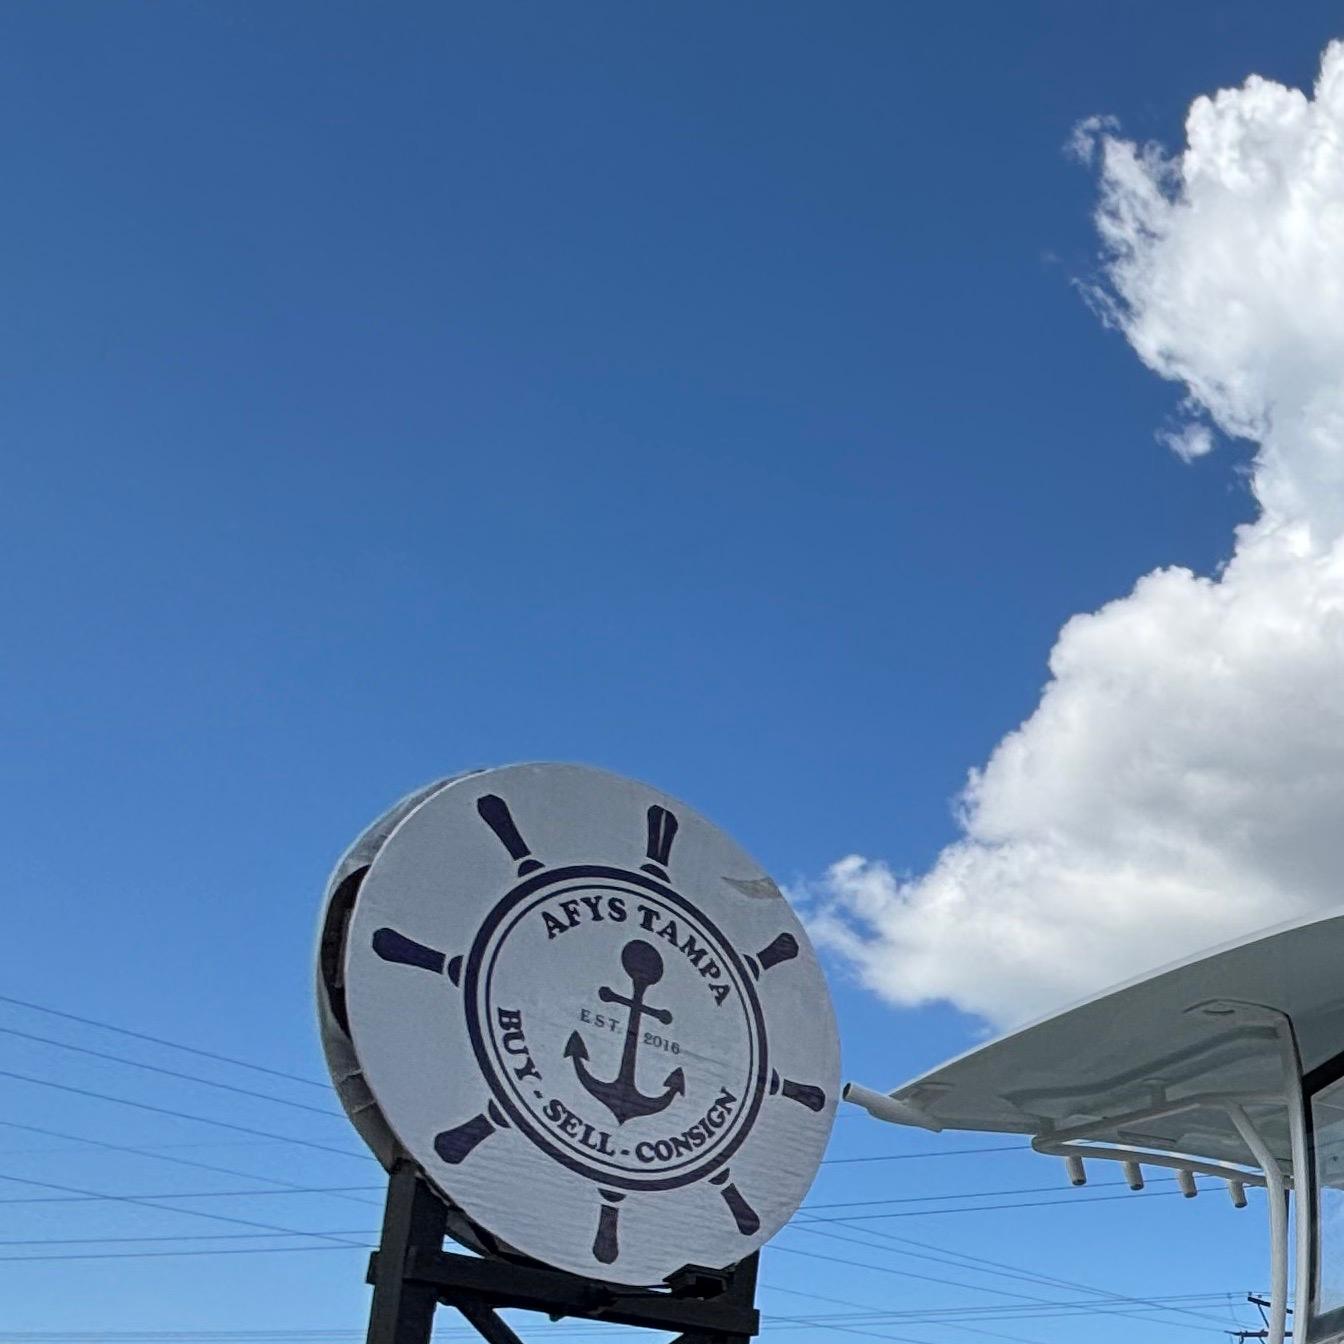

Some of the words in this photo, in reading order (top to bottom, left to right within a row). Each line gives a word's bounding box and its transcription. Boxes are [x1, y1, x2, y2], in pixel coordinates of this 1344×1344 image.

[541, 895, 627, 939] AFYS
[638, 904, 730, 1007] TAMPA
[497, 1006, 544, 1081] BUY
[543, 1099, 616, 1156] SELL
[635, 1086, 738, 1163] CONSIGN
[580, 1008, 623, 1034] EST.
[643, 1032, 681, 1055] 2016
